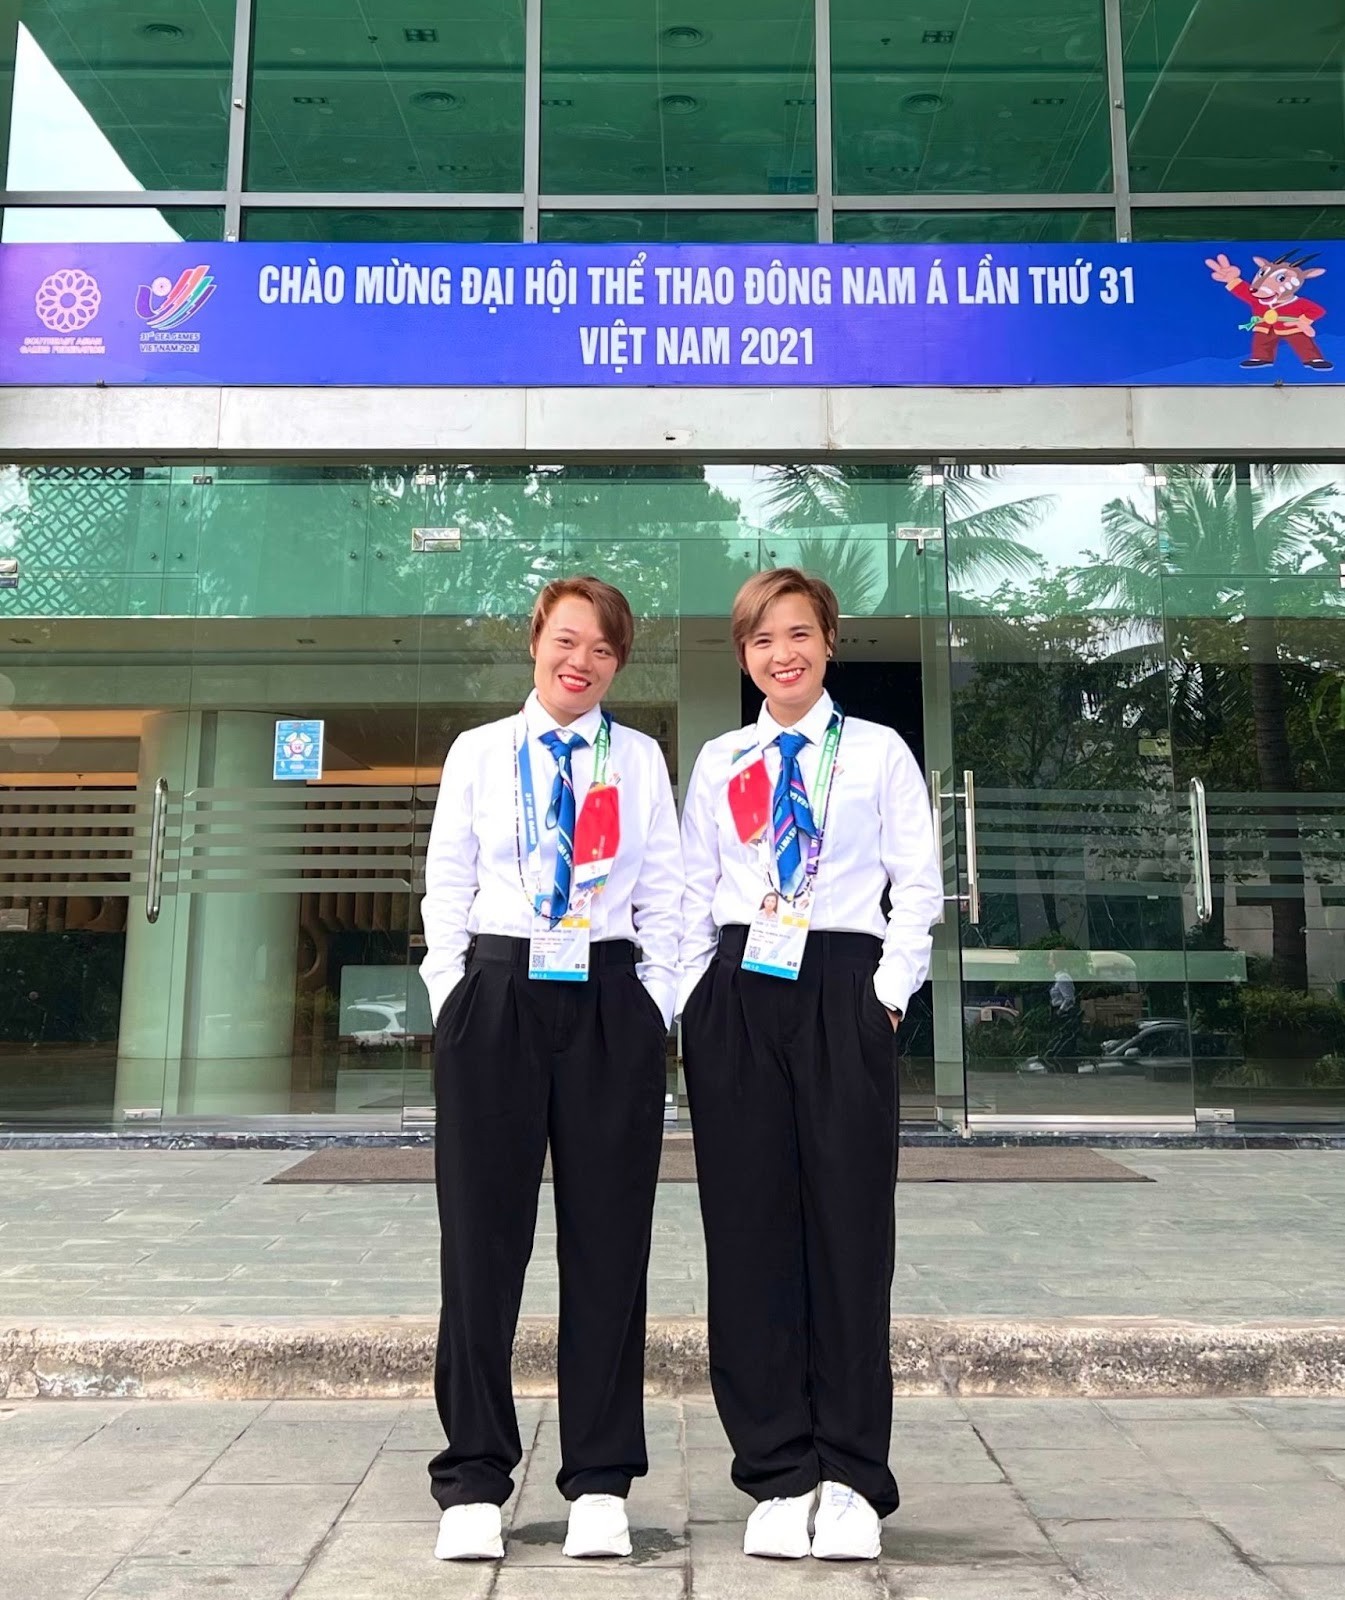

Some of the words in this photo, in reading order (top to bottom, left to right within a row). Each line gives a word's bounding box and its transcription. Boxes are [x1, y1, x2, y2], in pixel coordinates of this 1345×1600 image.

[259, 257, 345, 304] CHÀO
[355, 257, 451, 305] MỪNG
[460, 266, 515, 314] ĐẠI
[525, 259, 577, 314] HỘI
[587, 251, 647, 305] THỂ
[654, 266, 735, 305] THAO
[743, 258, 832, 306] ĐÔNG
[842, 266, 916, 305] NAM
[926, 257, 949, 304] Á
[957, 253, 1019, 304] LẦN
[1028, 257, 1092, 304] THỨ
[1099, 266, 1134, 304] 31
[579, 318, 647, 374] VIỆT
[656, 326, 730, 365] NAM
[740, 327, 813, 366] 2021
